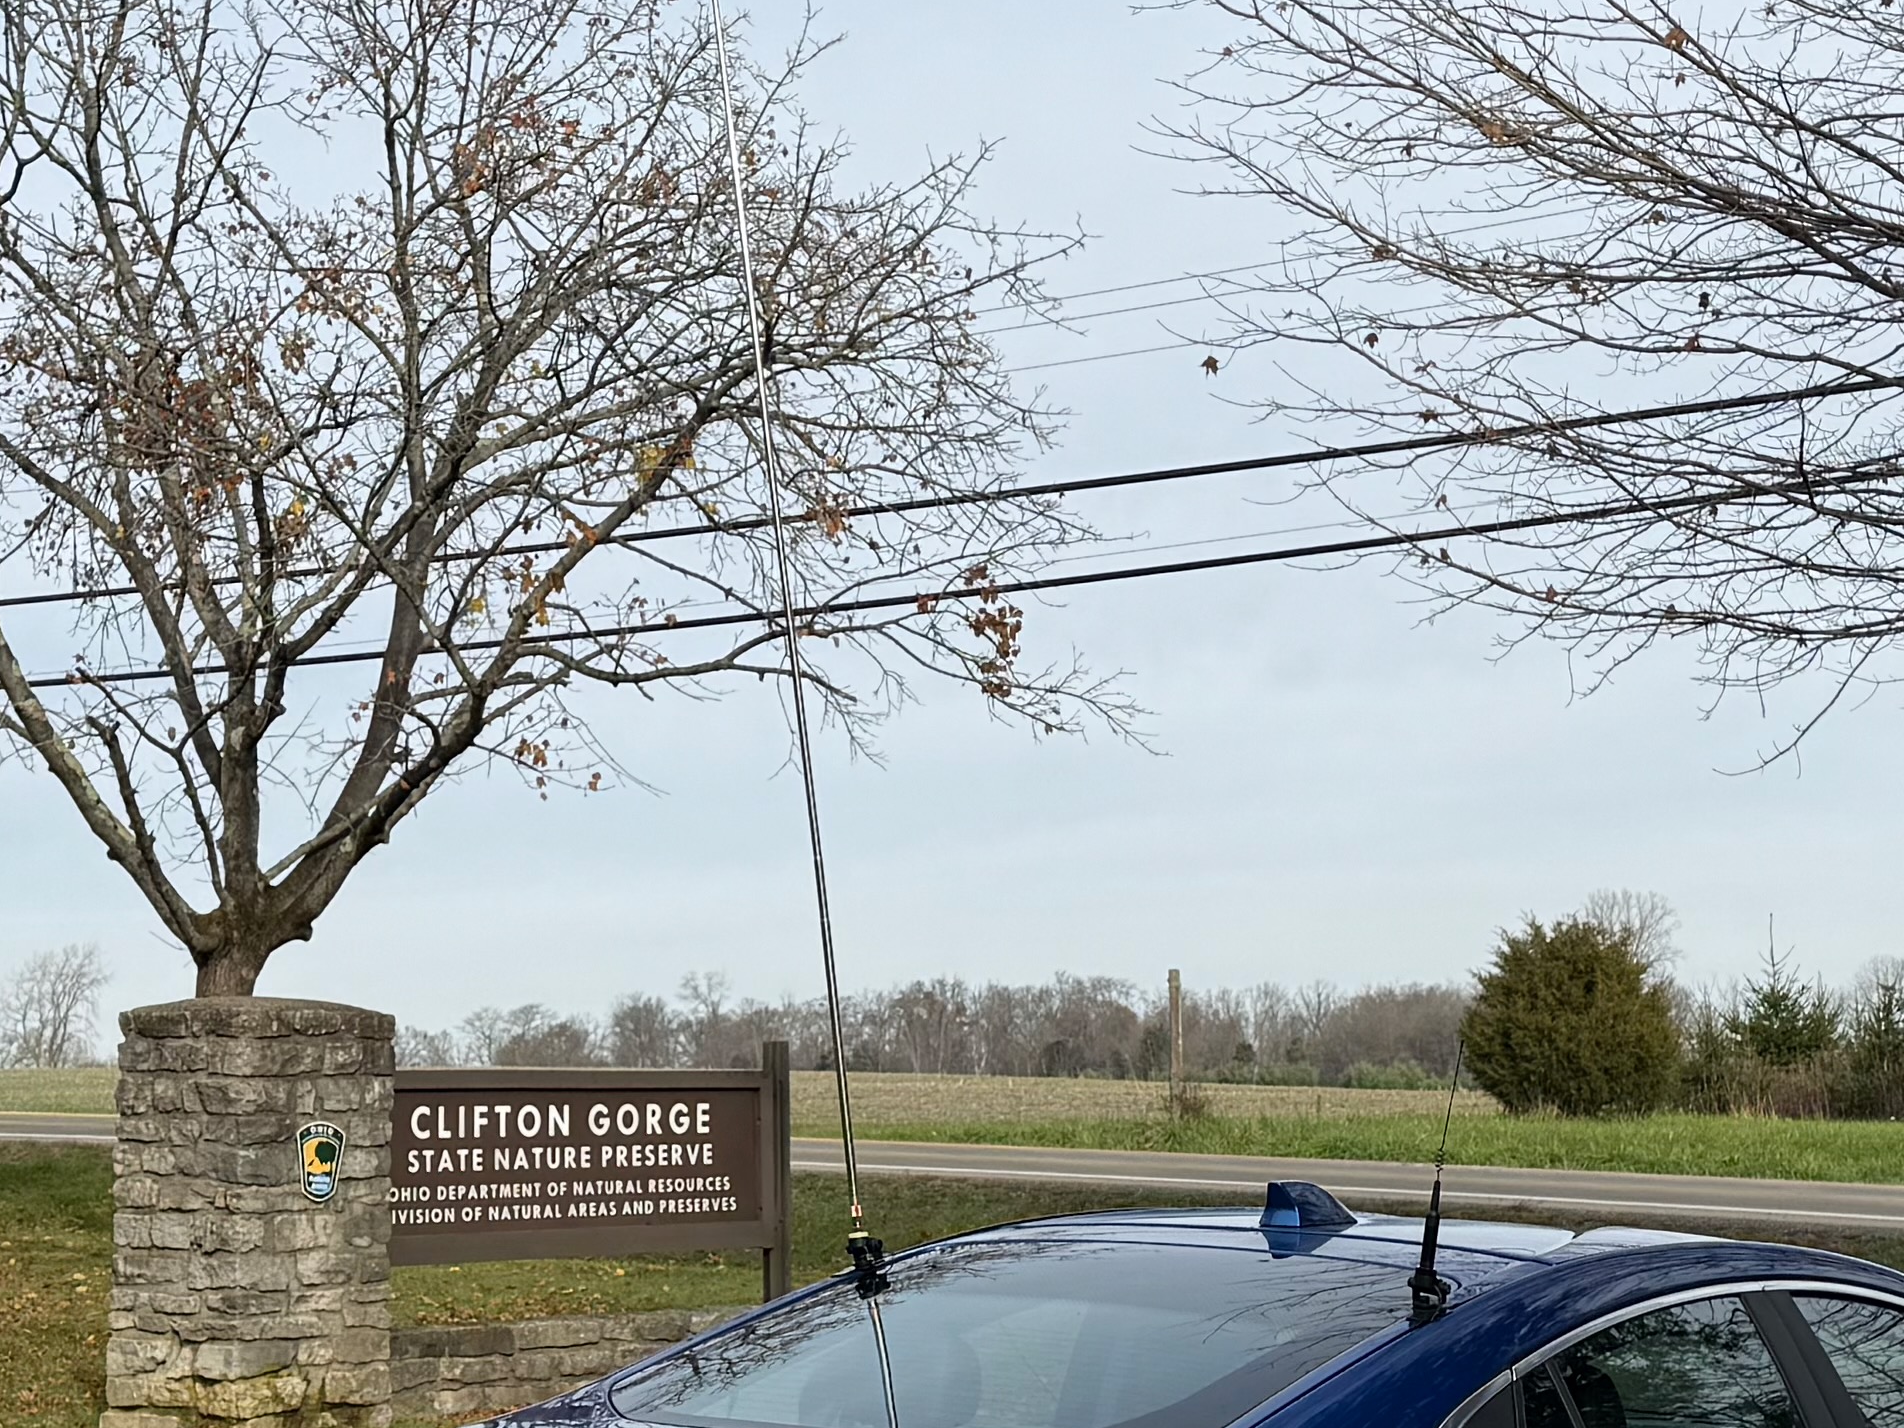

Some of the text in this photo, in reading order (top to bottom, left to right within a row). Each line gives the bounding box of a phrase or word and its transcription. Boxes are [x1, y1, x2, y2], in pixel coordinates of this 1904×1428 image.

[410, 1103, 710, 1140] CLIFTON GORGE
[407, 1143, 713, 1173] STATE NATURE PRESERVE
[390, 1176, 731, 1203] OHIO DEPARTMENT OF NATURAL RESOURCES
[391, 1197, 738, 1225] IVISION OF NATURAL AREAS AND PRESERVES
